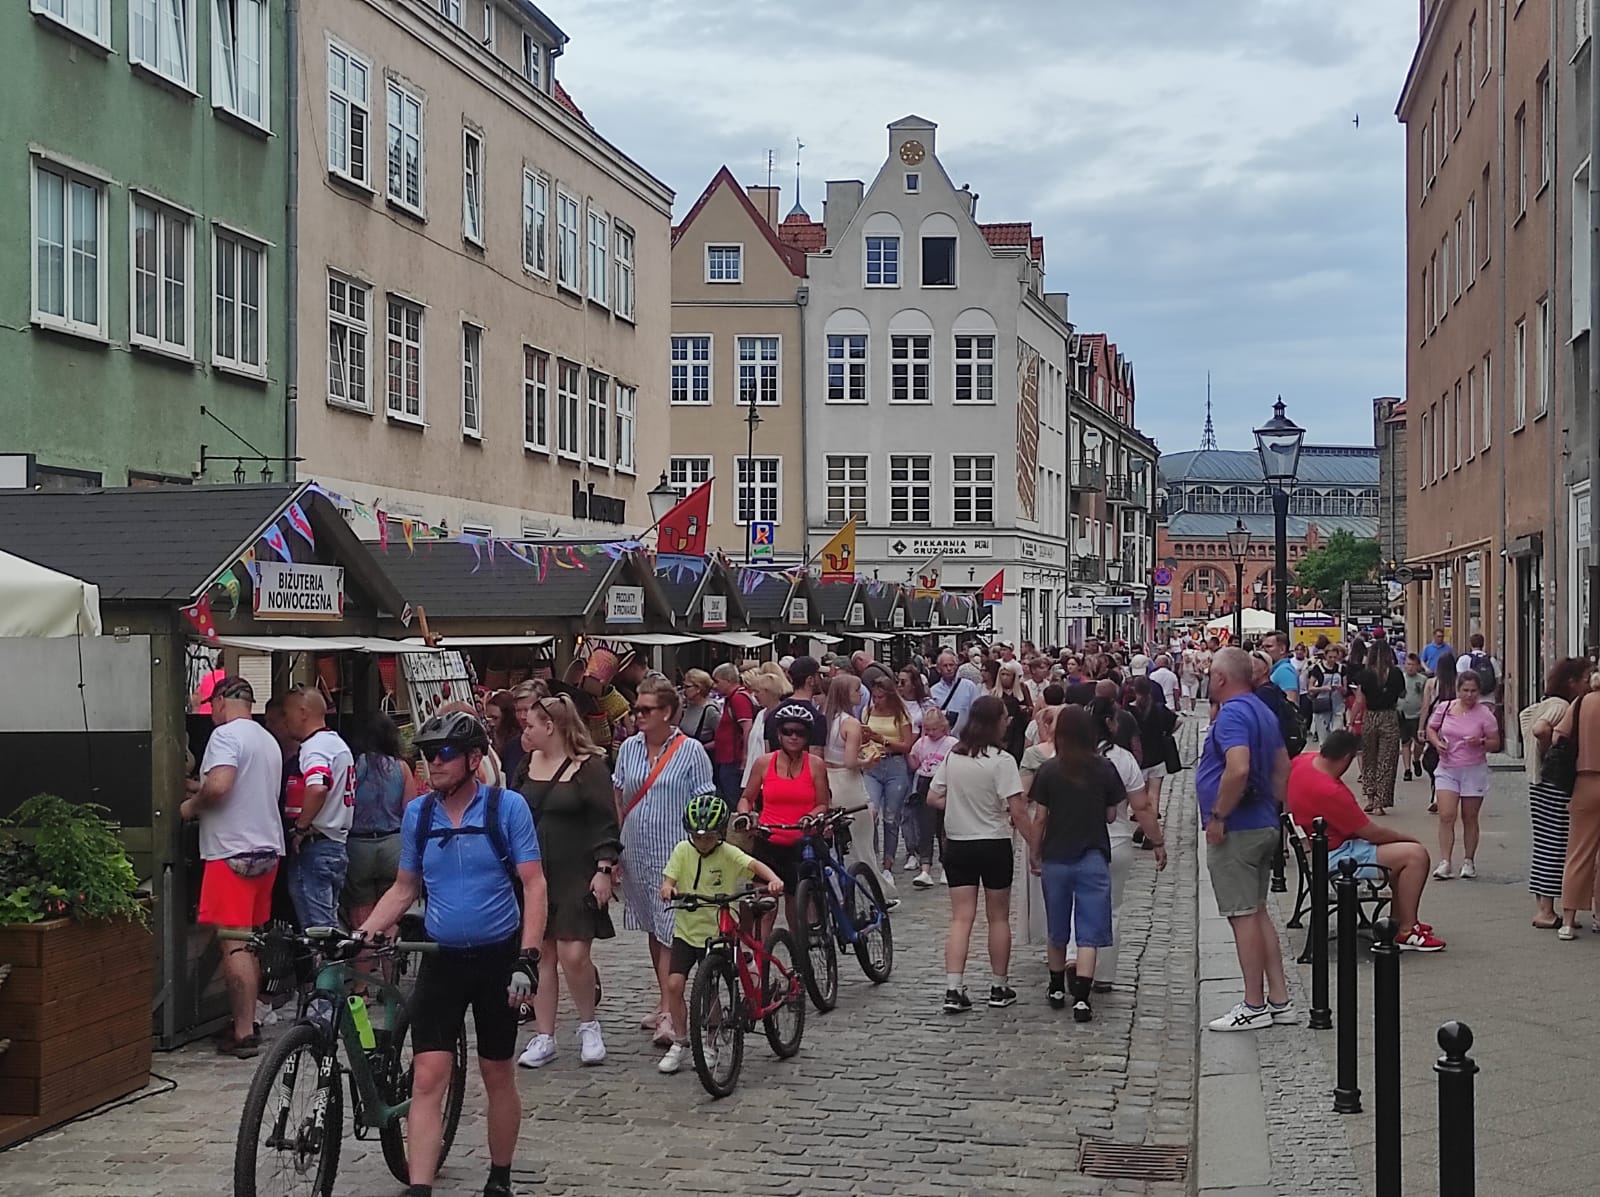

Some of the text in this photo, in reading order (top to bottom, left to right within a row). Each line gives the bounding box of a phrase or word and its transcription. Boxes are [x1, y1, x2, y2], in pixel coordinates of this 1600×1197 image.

[278, 567, 324, 591] BIŻUTERIA
[268, 591, 332, 610] NOWOCZESNA
[320, 1056, 333, 1077] 32
